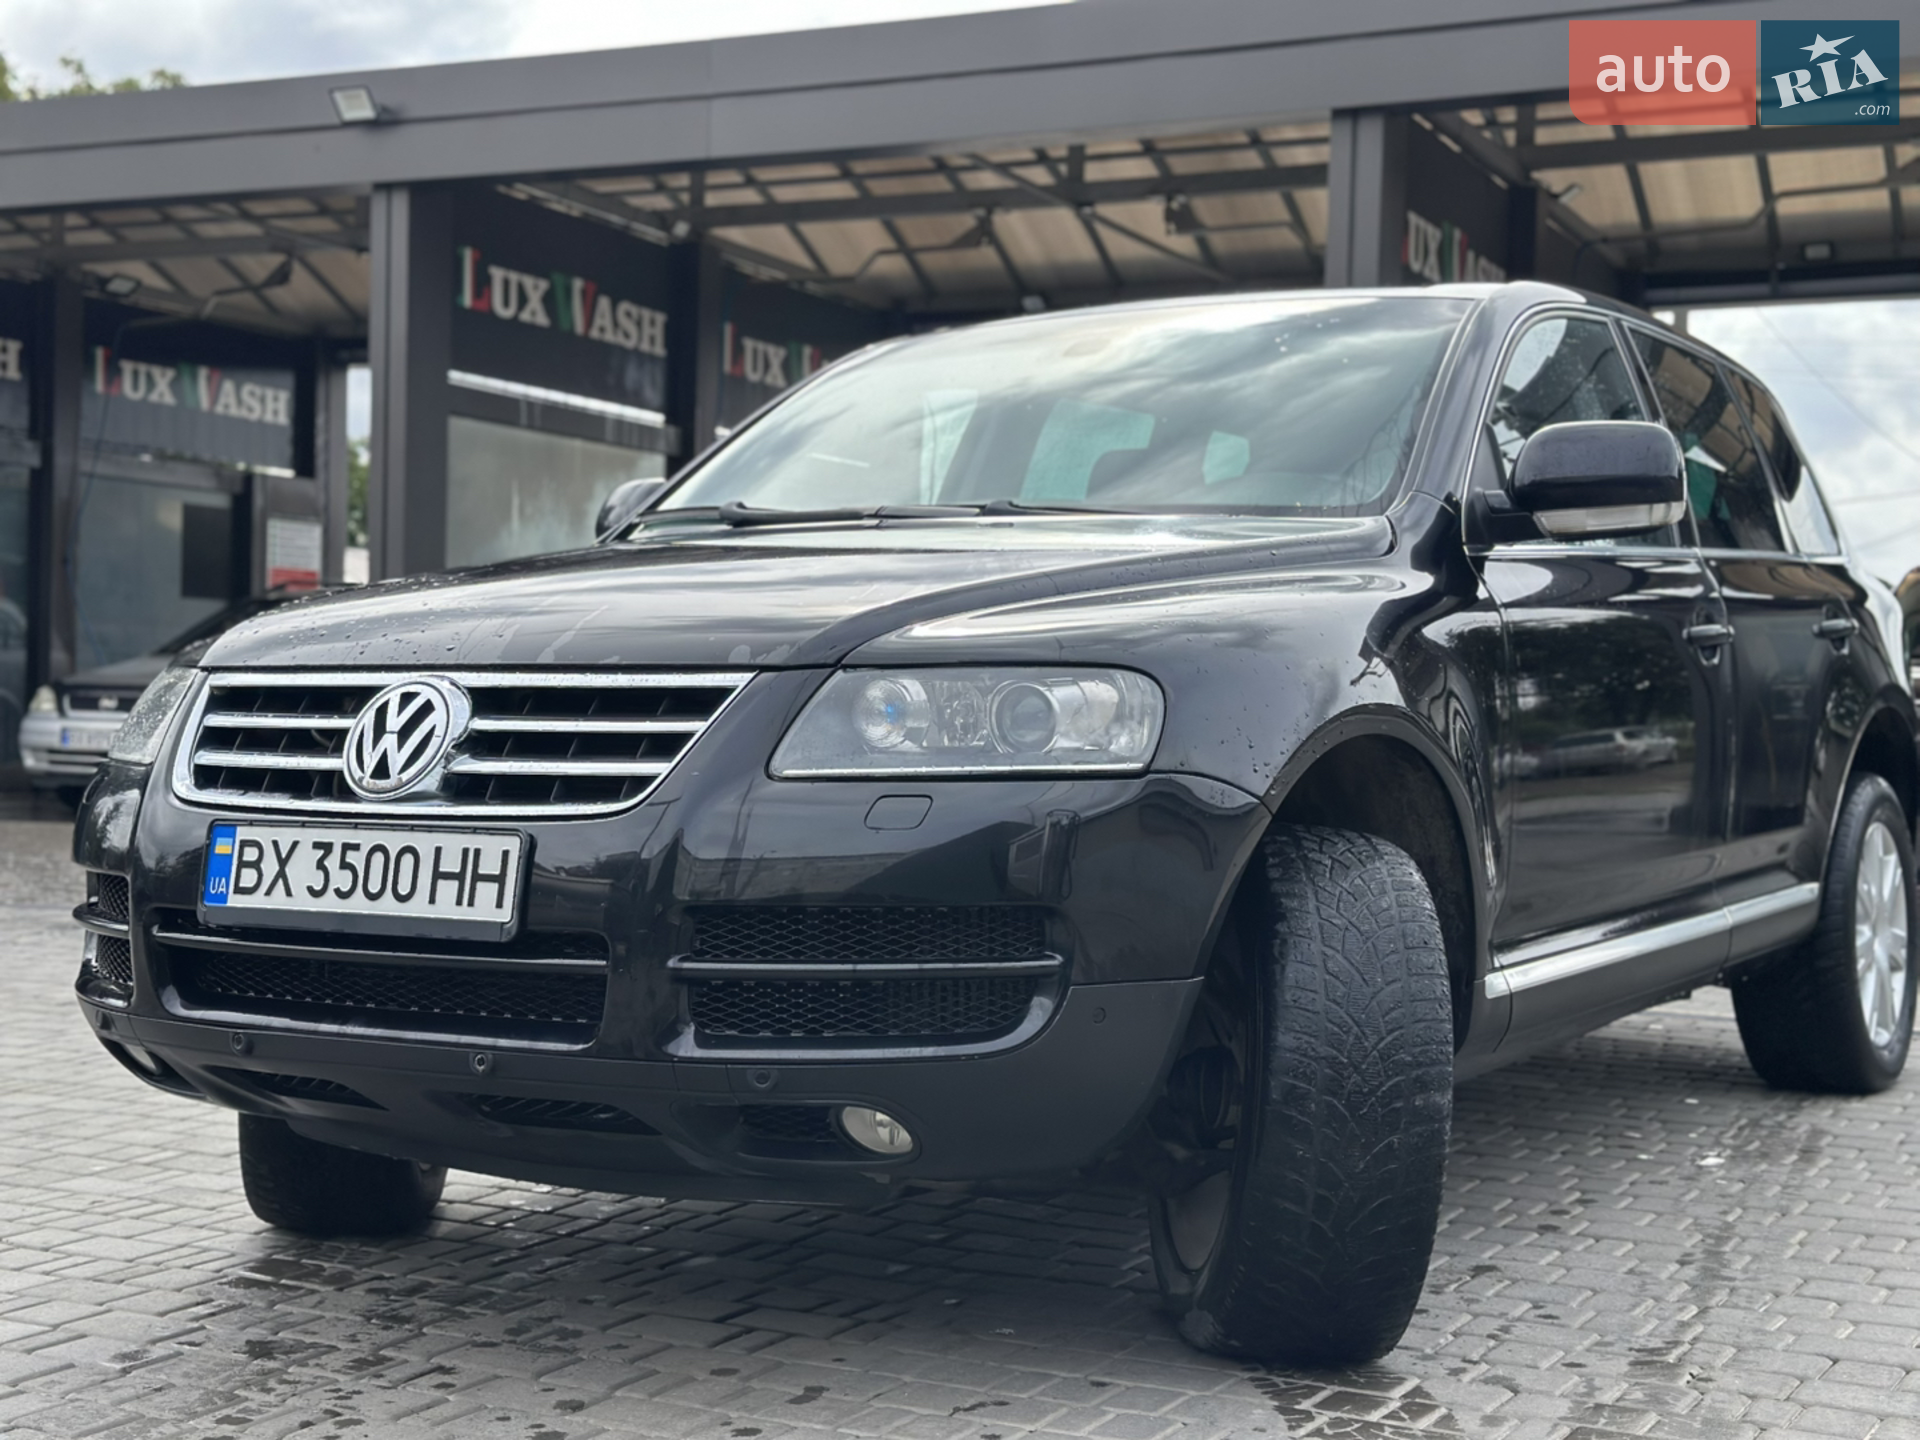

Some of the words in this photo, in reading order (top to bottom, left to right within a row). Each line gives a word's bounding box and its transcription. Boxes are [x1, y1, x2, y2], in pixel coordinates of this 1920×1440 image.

[1402, 209, 1442, 283] UX
[456, 246, 551, 328] LUX
[551, 271, 668, 358] WASH
[91, 345, 177, 406] LUX
[178, 361, 291, 425] WASH
[722, 320, 788, 389] LUX
[209, 876, 227, 895] UA
[233, 838, 300, 897] BX
[306, 840, 421, 904] 3500
[428, 846, 510, 909] HH
